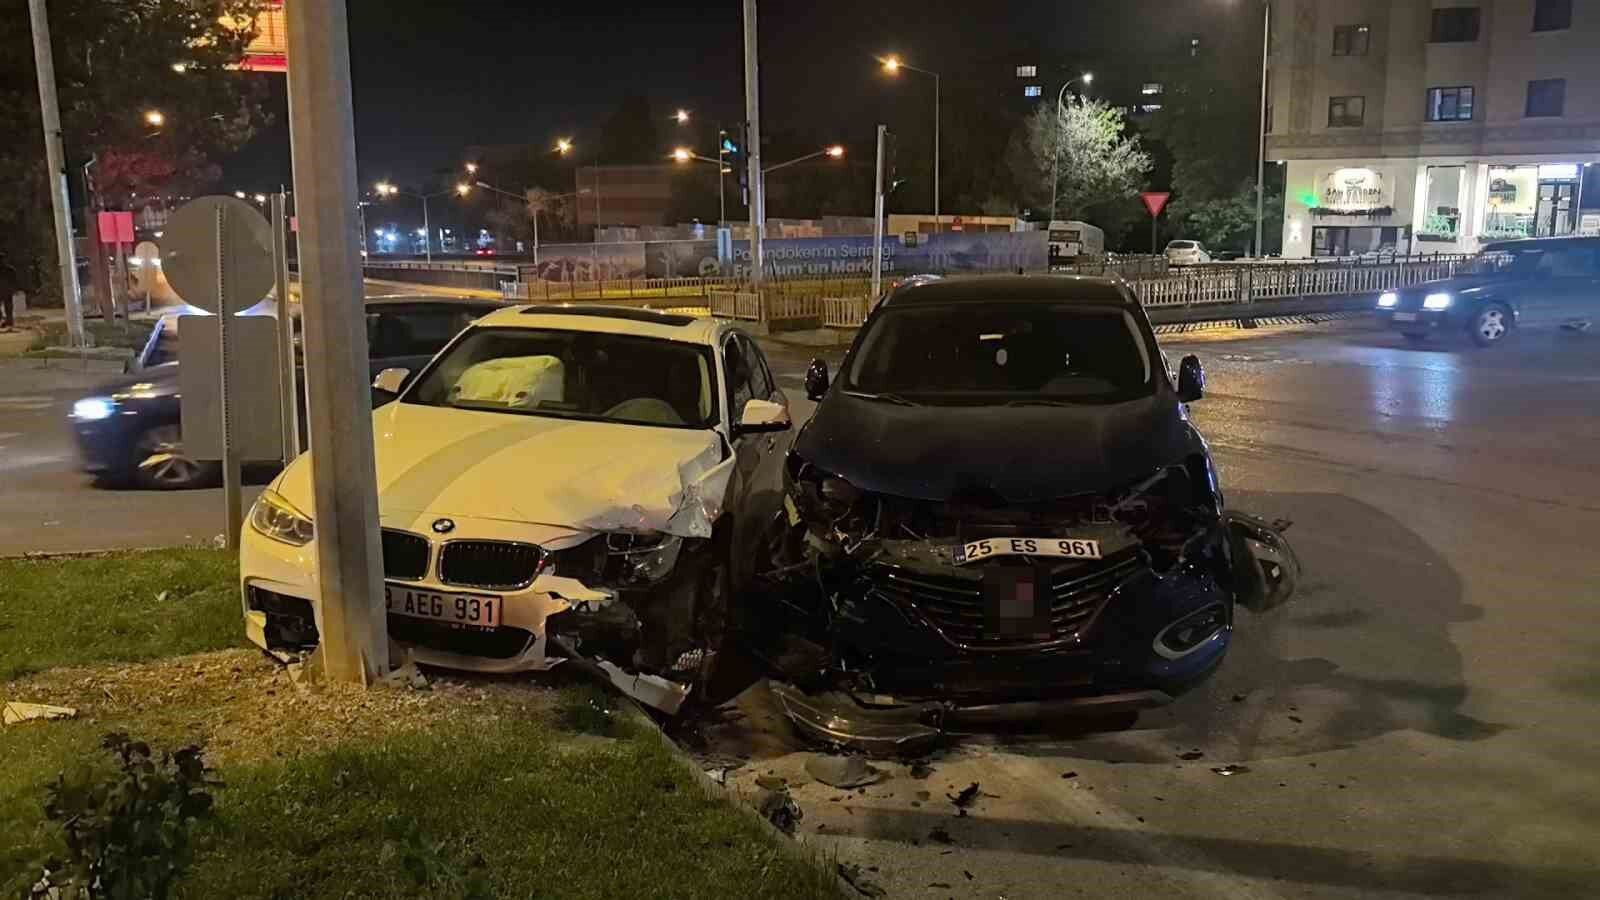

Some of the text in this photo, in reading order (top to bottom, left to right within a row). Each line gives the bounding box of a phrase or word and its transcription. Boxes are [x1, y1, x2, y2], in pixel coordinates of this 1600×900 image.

[966, 540, 1095, 559] 25 ES 961
[405, 591, 443, 617] AEG
[455, 597, 493, 623] 931
